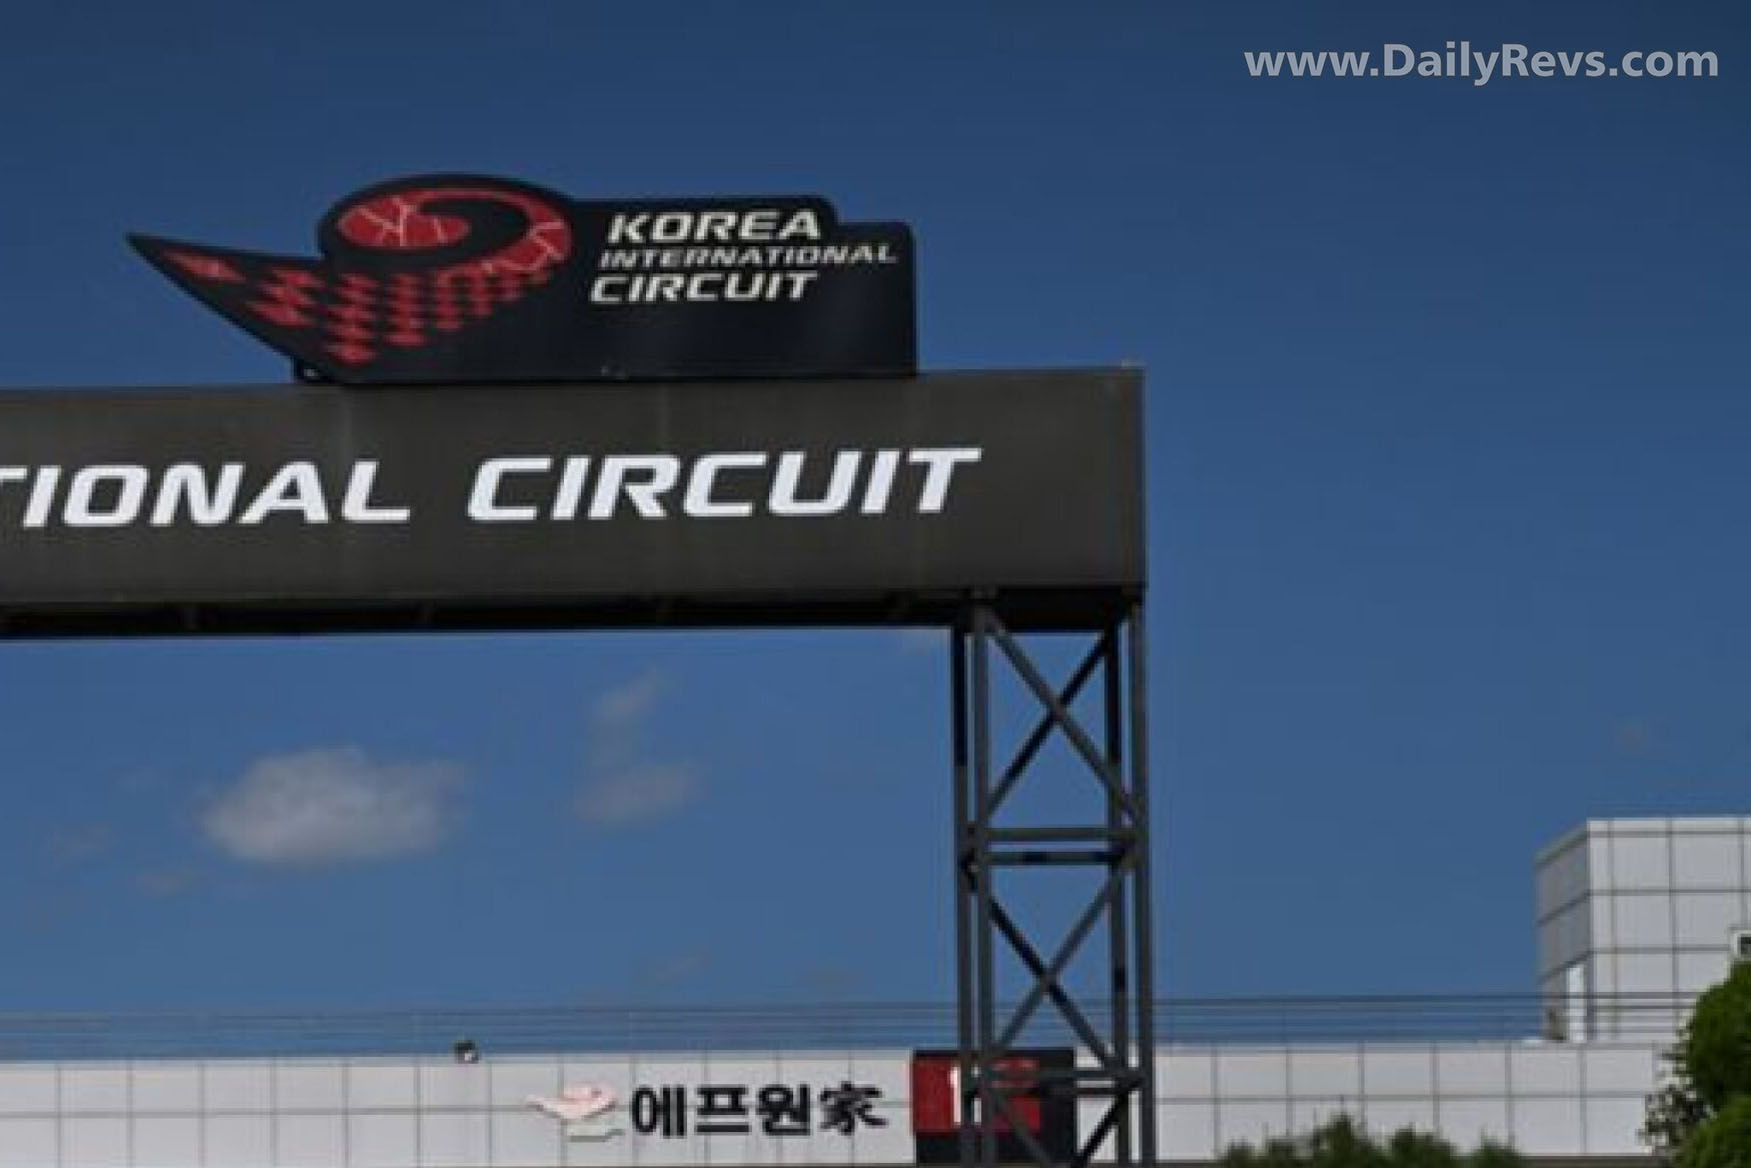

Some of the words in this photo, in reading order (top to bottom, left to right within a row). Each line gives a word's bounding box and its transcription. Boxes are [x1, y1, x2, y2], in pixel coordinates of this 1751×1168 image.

[607, 208, 822, 243] KOREA
[599, 244, 897, 270] INTERNATIONAL
[590, 270, 819, 304] CIRCUIT
[466, 446, 983, 522] CIRCUIT
[631, 1081, 888, 1138] 에프원家
